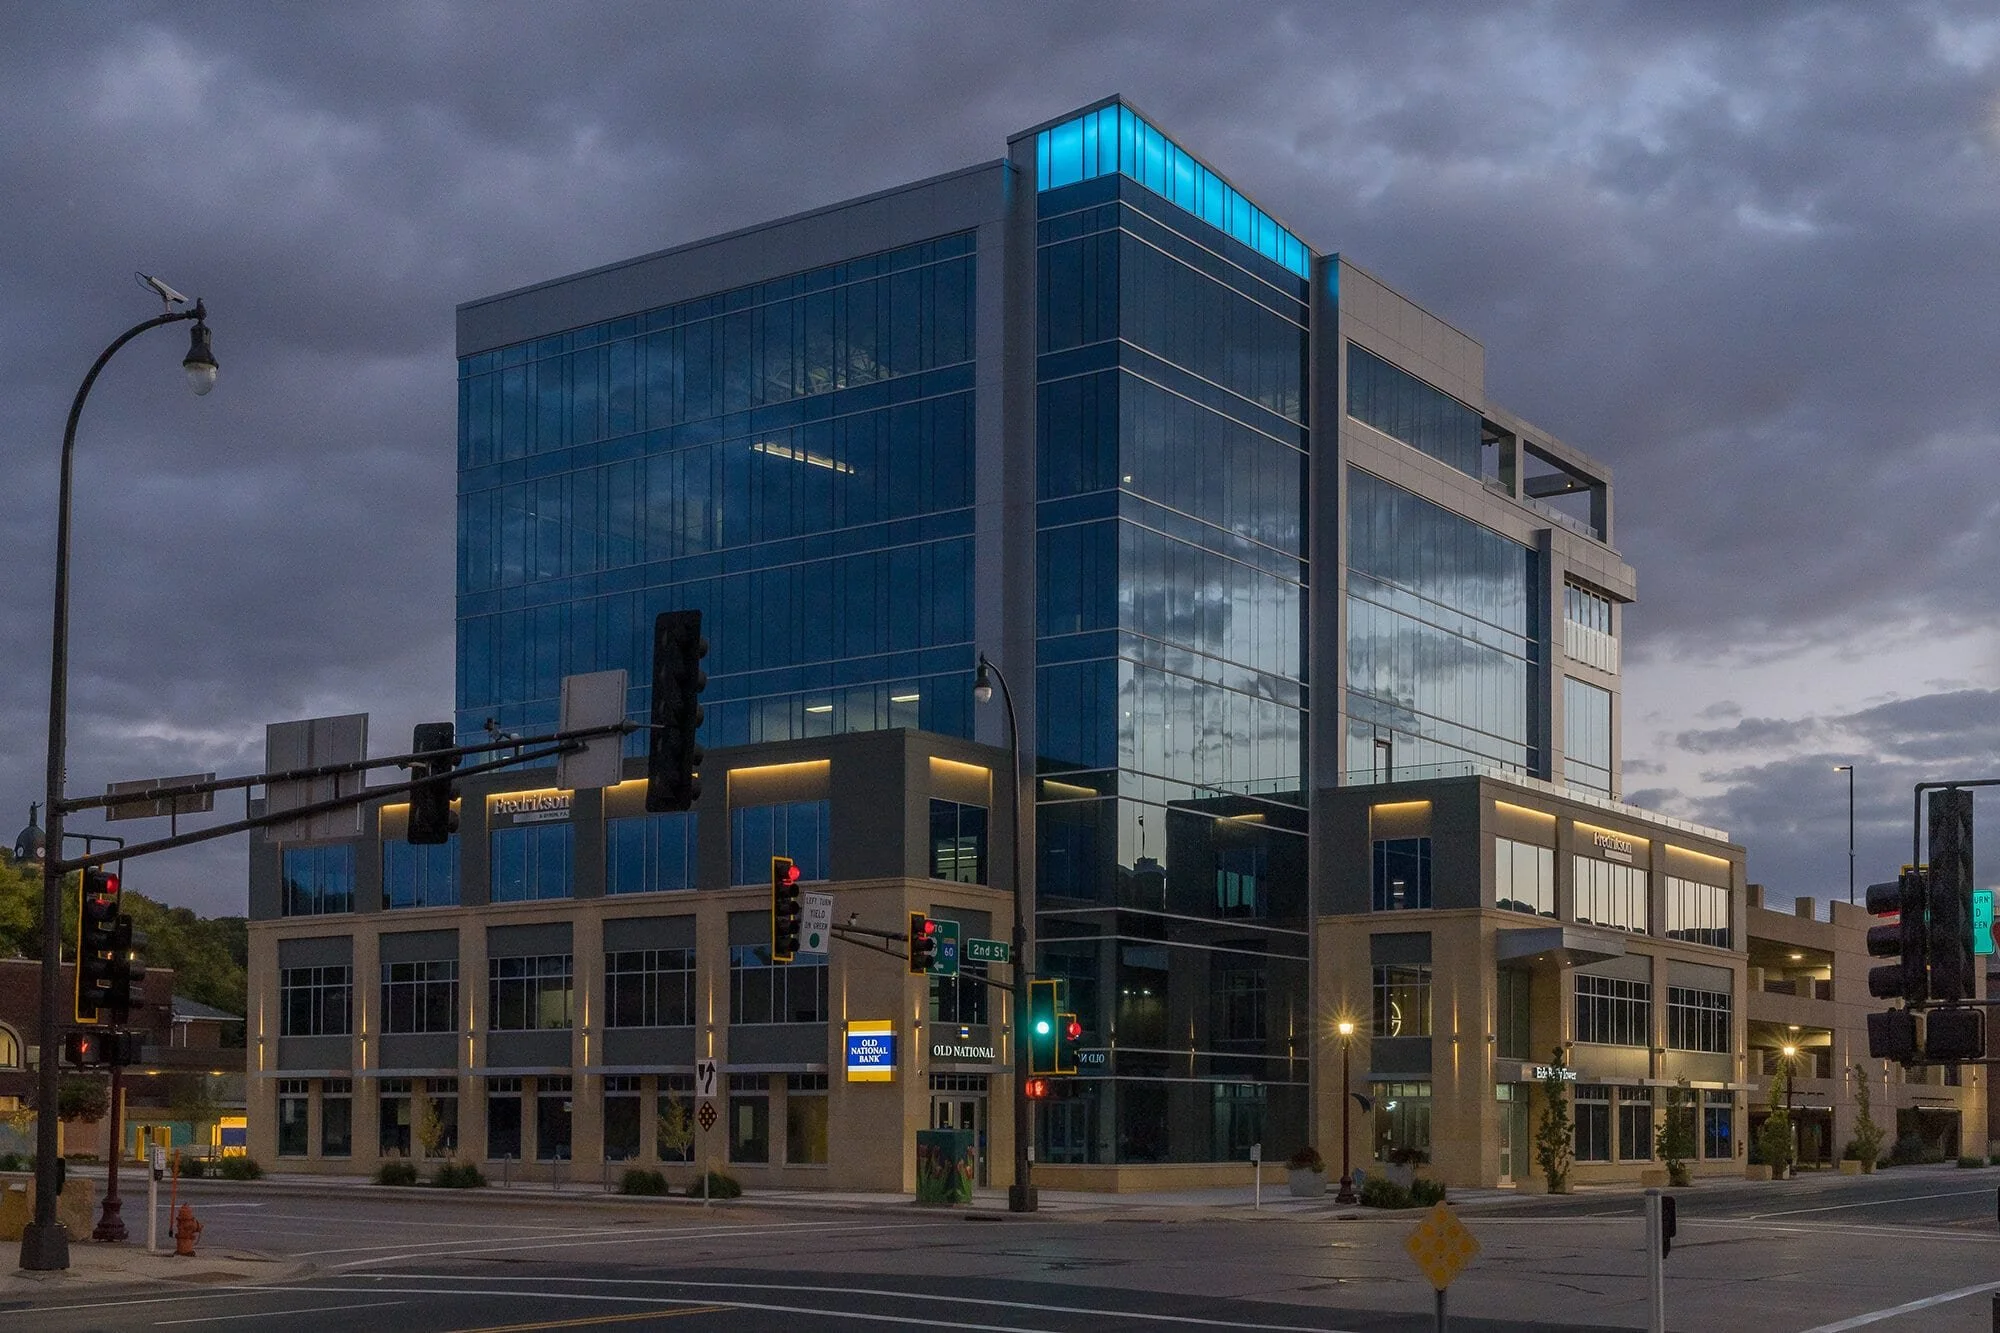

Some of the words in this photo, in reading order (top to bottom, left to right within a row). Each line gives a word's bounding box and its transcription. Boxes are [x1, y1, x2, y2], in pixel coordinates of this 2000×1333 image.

[494, 793, 570, 815] Fredrikson
[1974, 895, 1989, 904] URN
[944, 947, 954, 957] 60
[974, 944, 990, 956] 2nd
[994, 946, 1004, 957] St
[861, 1039, 878, 1047] OLD
[851, 1047, 888, 1055] NATIONAL
[933, 1044, 953, 1056] OLD
[953, 1045, 996, 1058] NATIONAL
[859, 1055, 881, 1063] BANK
